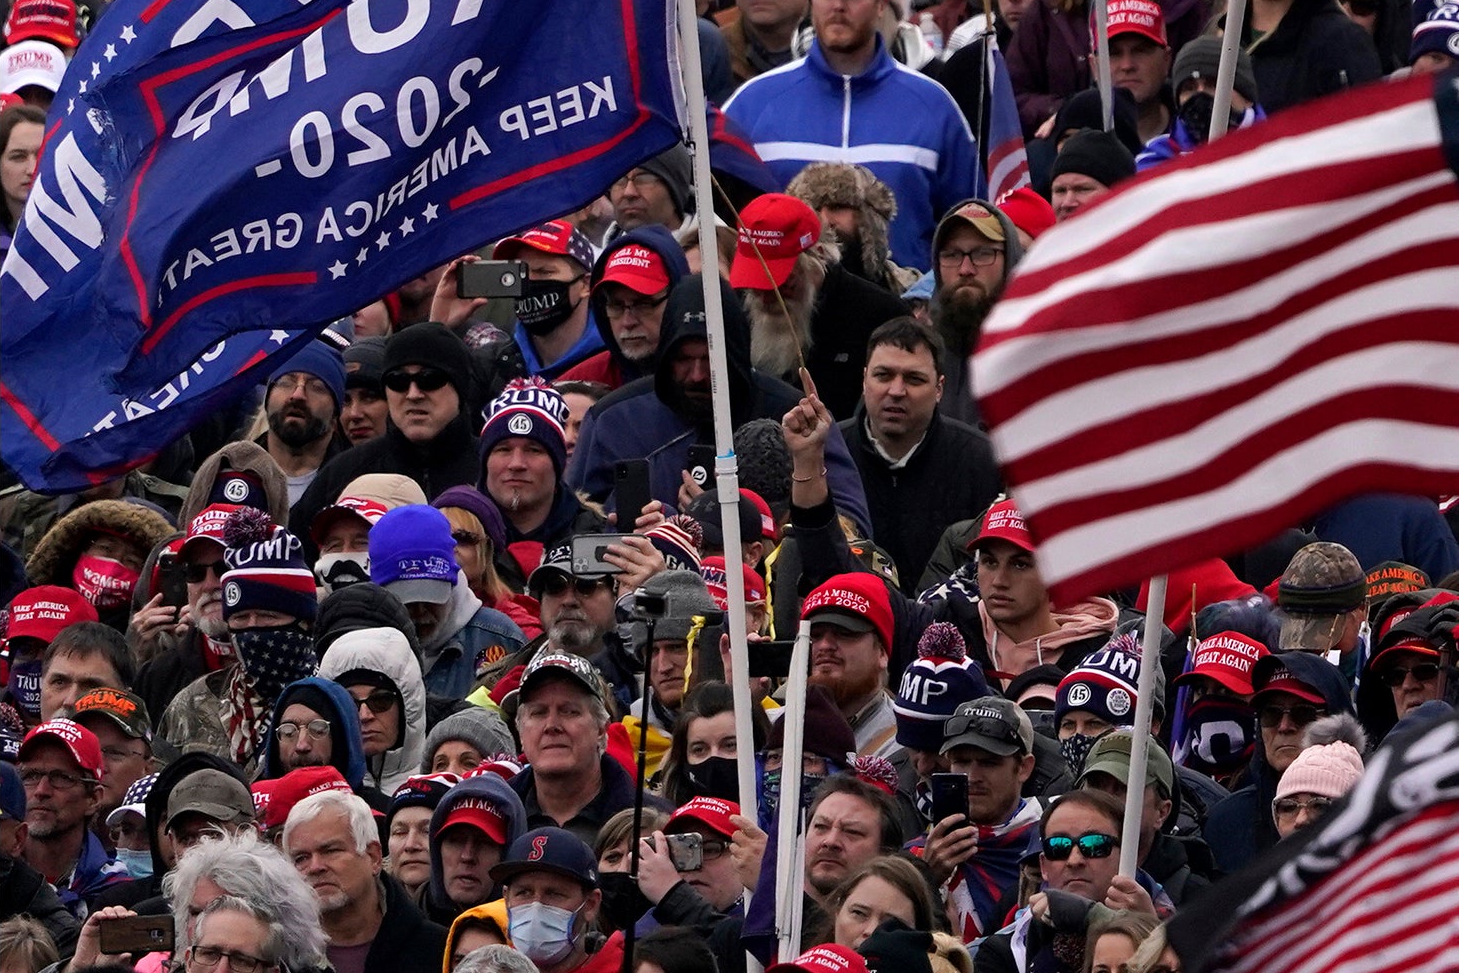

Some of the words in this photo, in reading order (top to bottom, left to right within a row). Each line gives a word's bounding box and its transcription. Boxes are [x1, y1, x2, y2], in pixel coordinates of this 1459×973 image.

[32, 601, 71, 613] AMERICA
[823, 588, 871, 609] AMERICA
[835, 597, 868, 614] 2020
[37, 610, 66, 620] AGAIN
[1216, 635, 1260, 660] AMERICA
[1219, 651, 1252, 674] AGAIN
[35, 723, 83, 739] AMERICA
[527, 835, 549, 862] S
